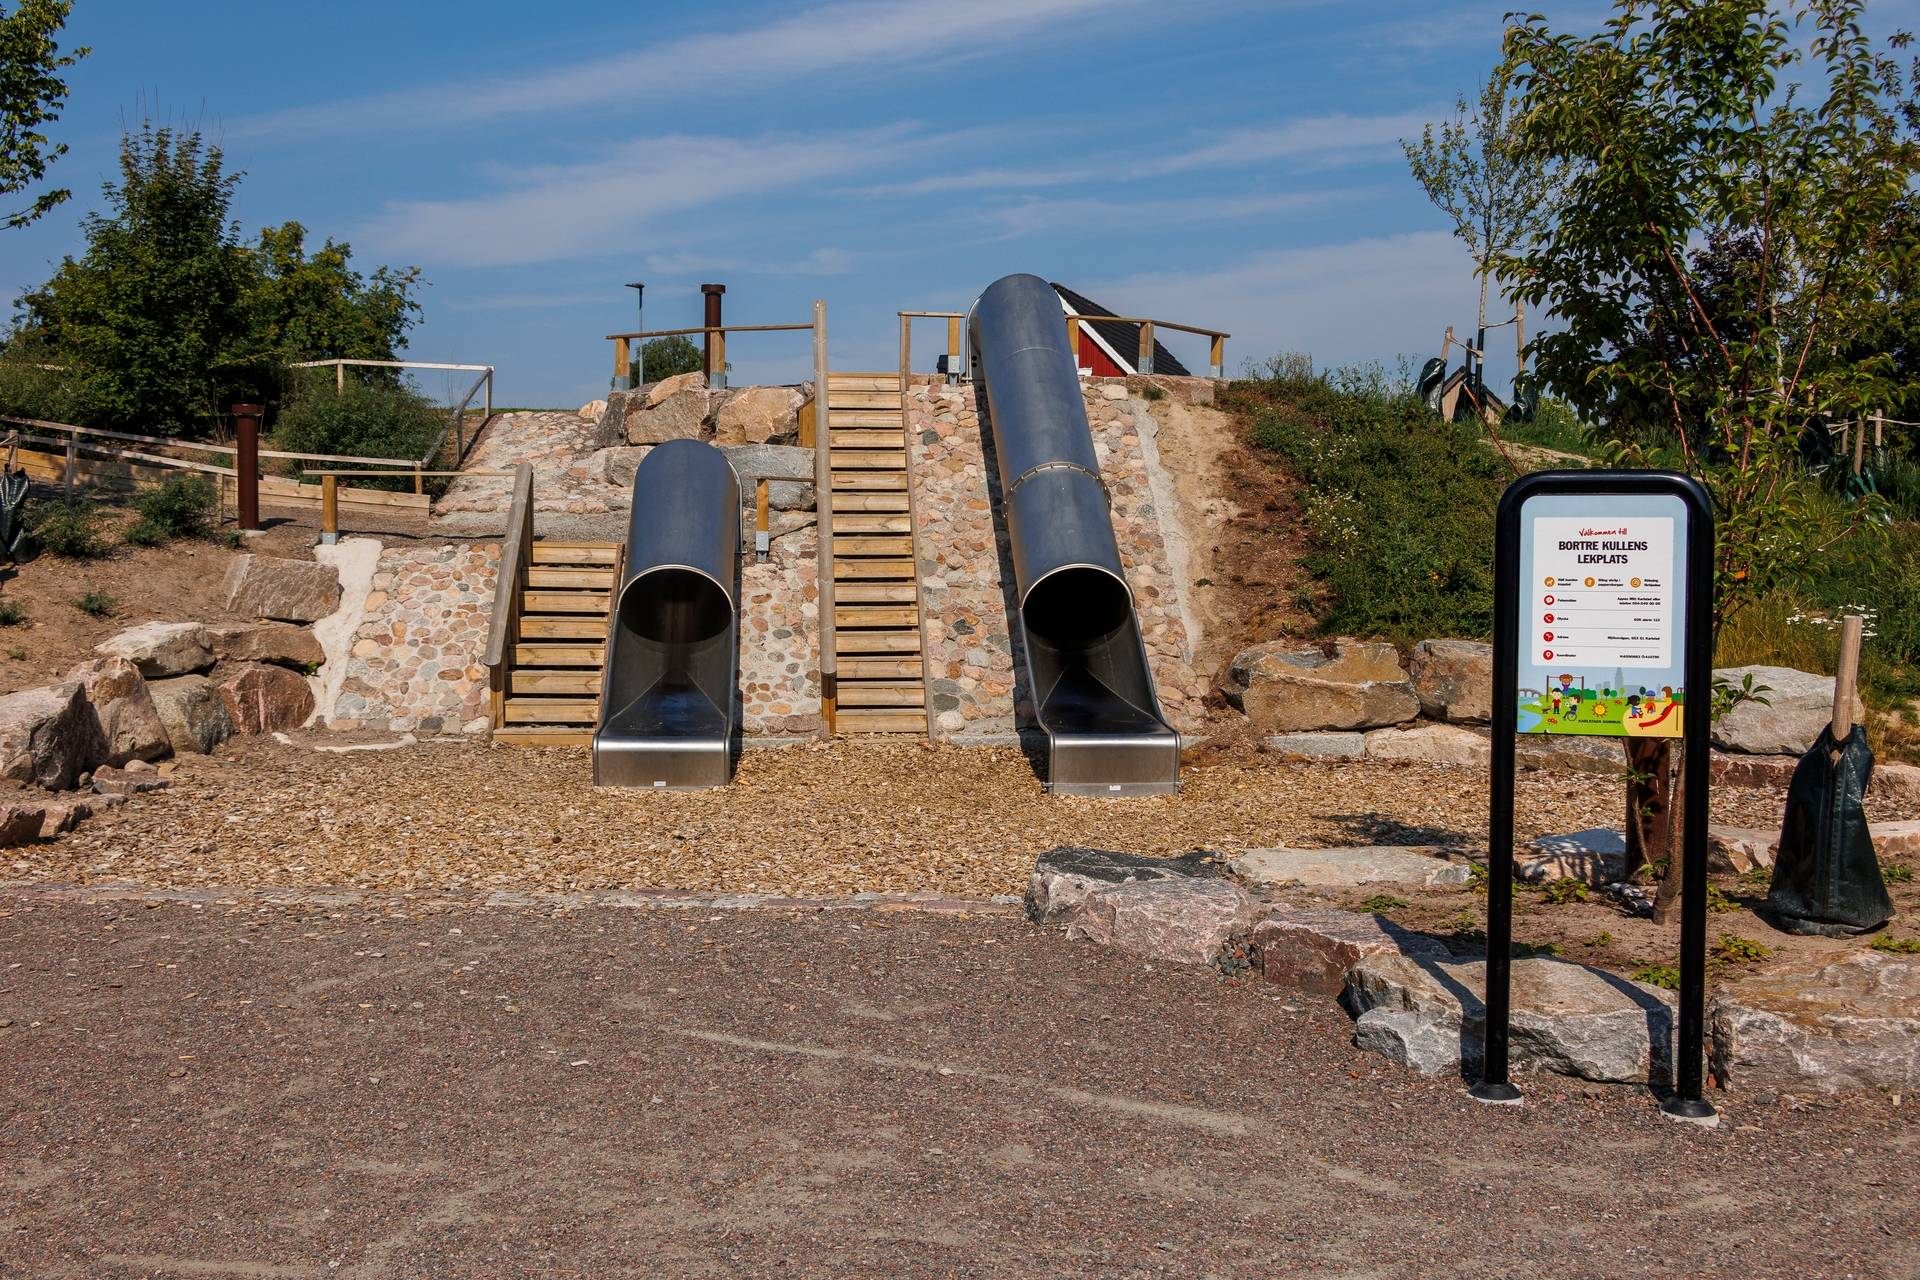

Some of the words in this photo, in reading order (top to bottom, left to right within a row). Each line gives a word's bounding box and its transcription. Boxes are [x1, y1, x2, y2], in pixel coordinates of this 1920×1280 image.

[1559, 541, 1599, 551] BORTRE
[1602, 541, 1648, 551] KULLENS
[1577, 554, 1628, 564] LEKPLATS
